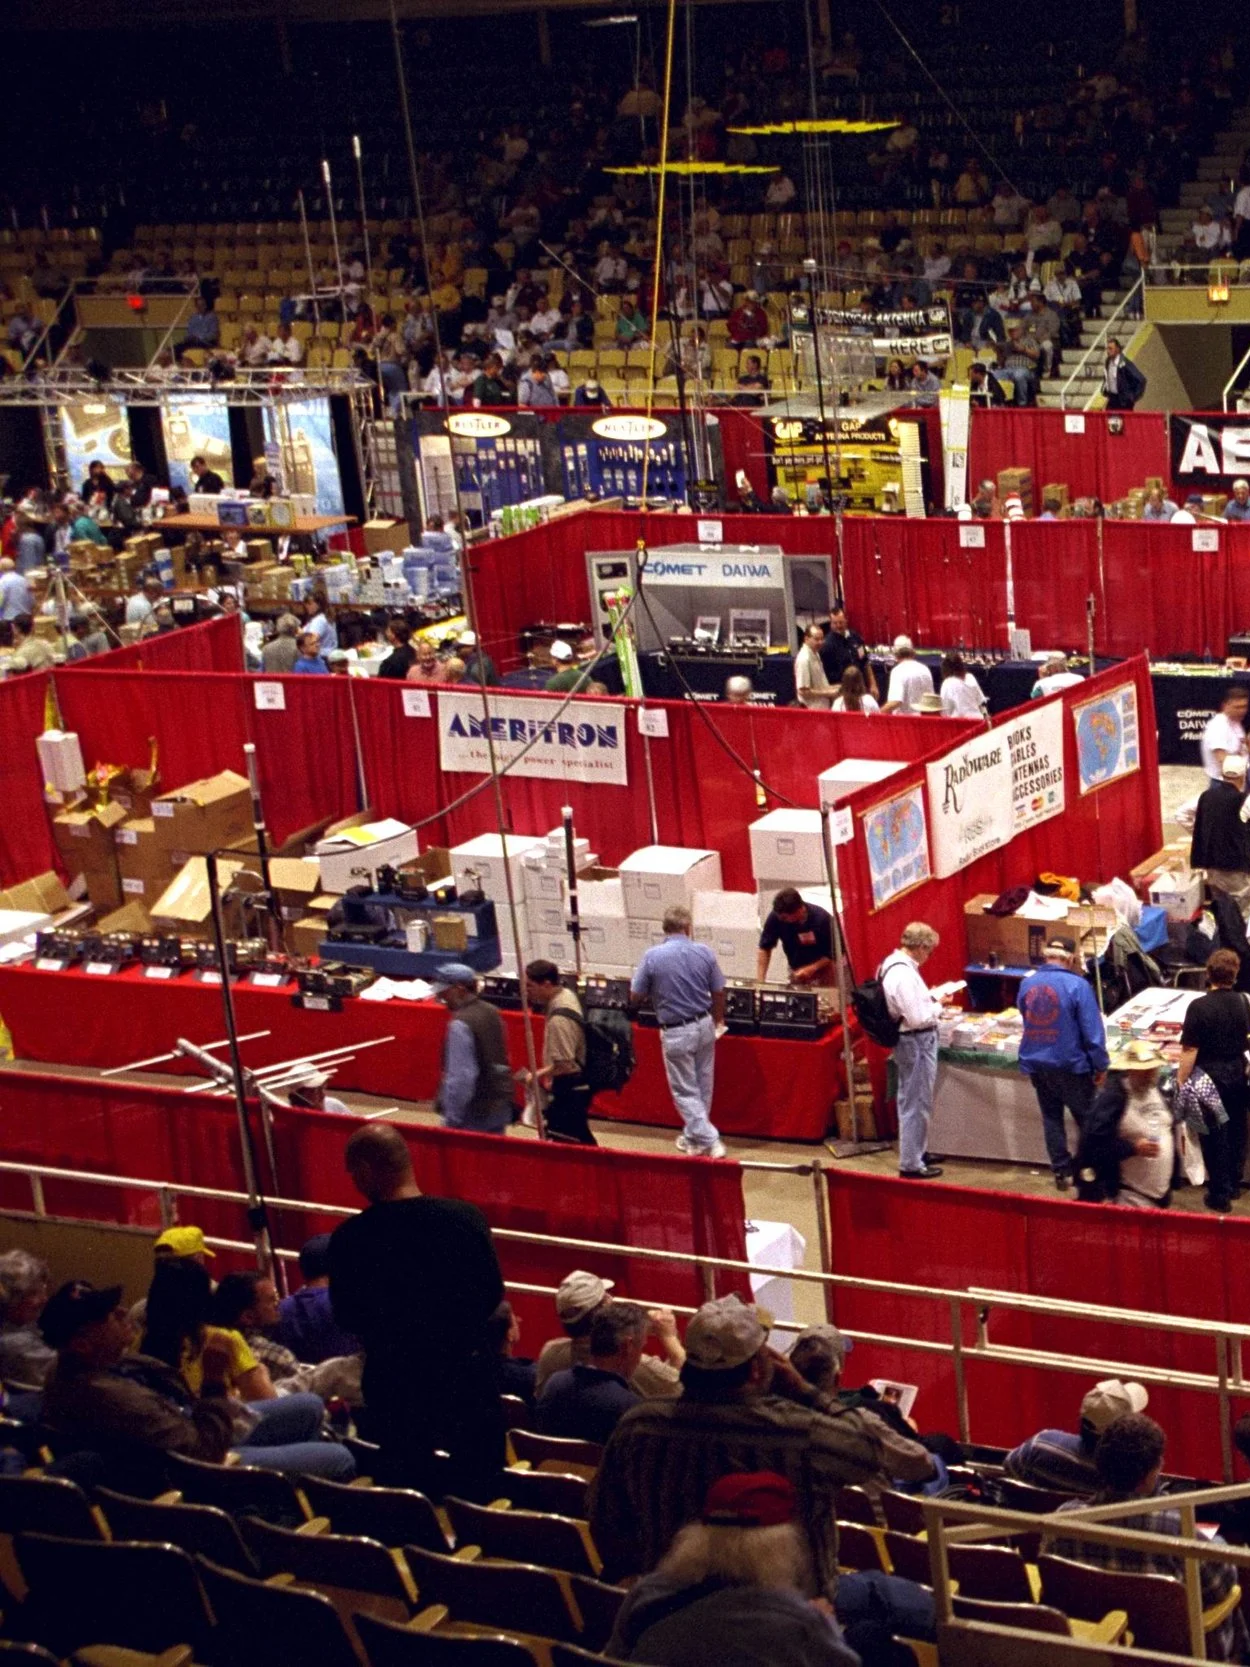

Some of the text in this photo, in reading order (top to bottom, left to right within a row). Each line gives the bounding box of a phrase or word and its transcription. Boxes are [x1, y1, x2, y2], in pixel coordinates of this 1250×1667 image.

[890, 340, 930, 356] HERE
[851, 432, 885, 441] PRODUCTS
[642, 561, 771, 578] COMET DAIWA
[448, 713, 618, 749] AMERITRON
[562, 758, 613, 770] specialist
